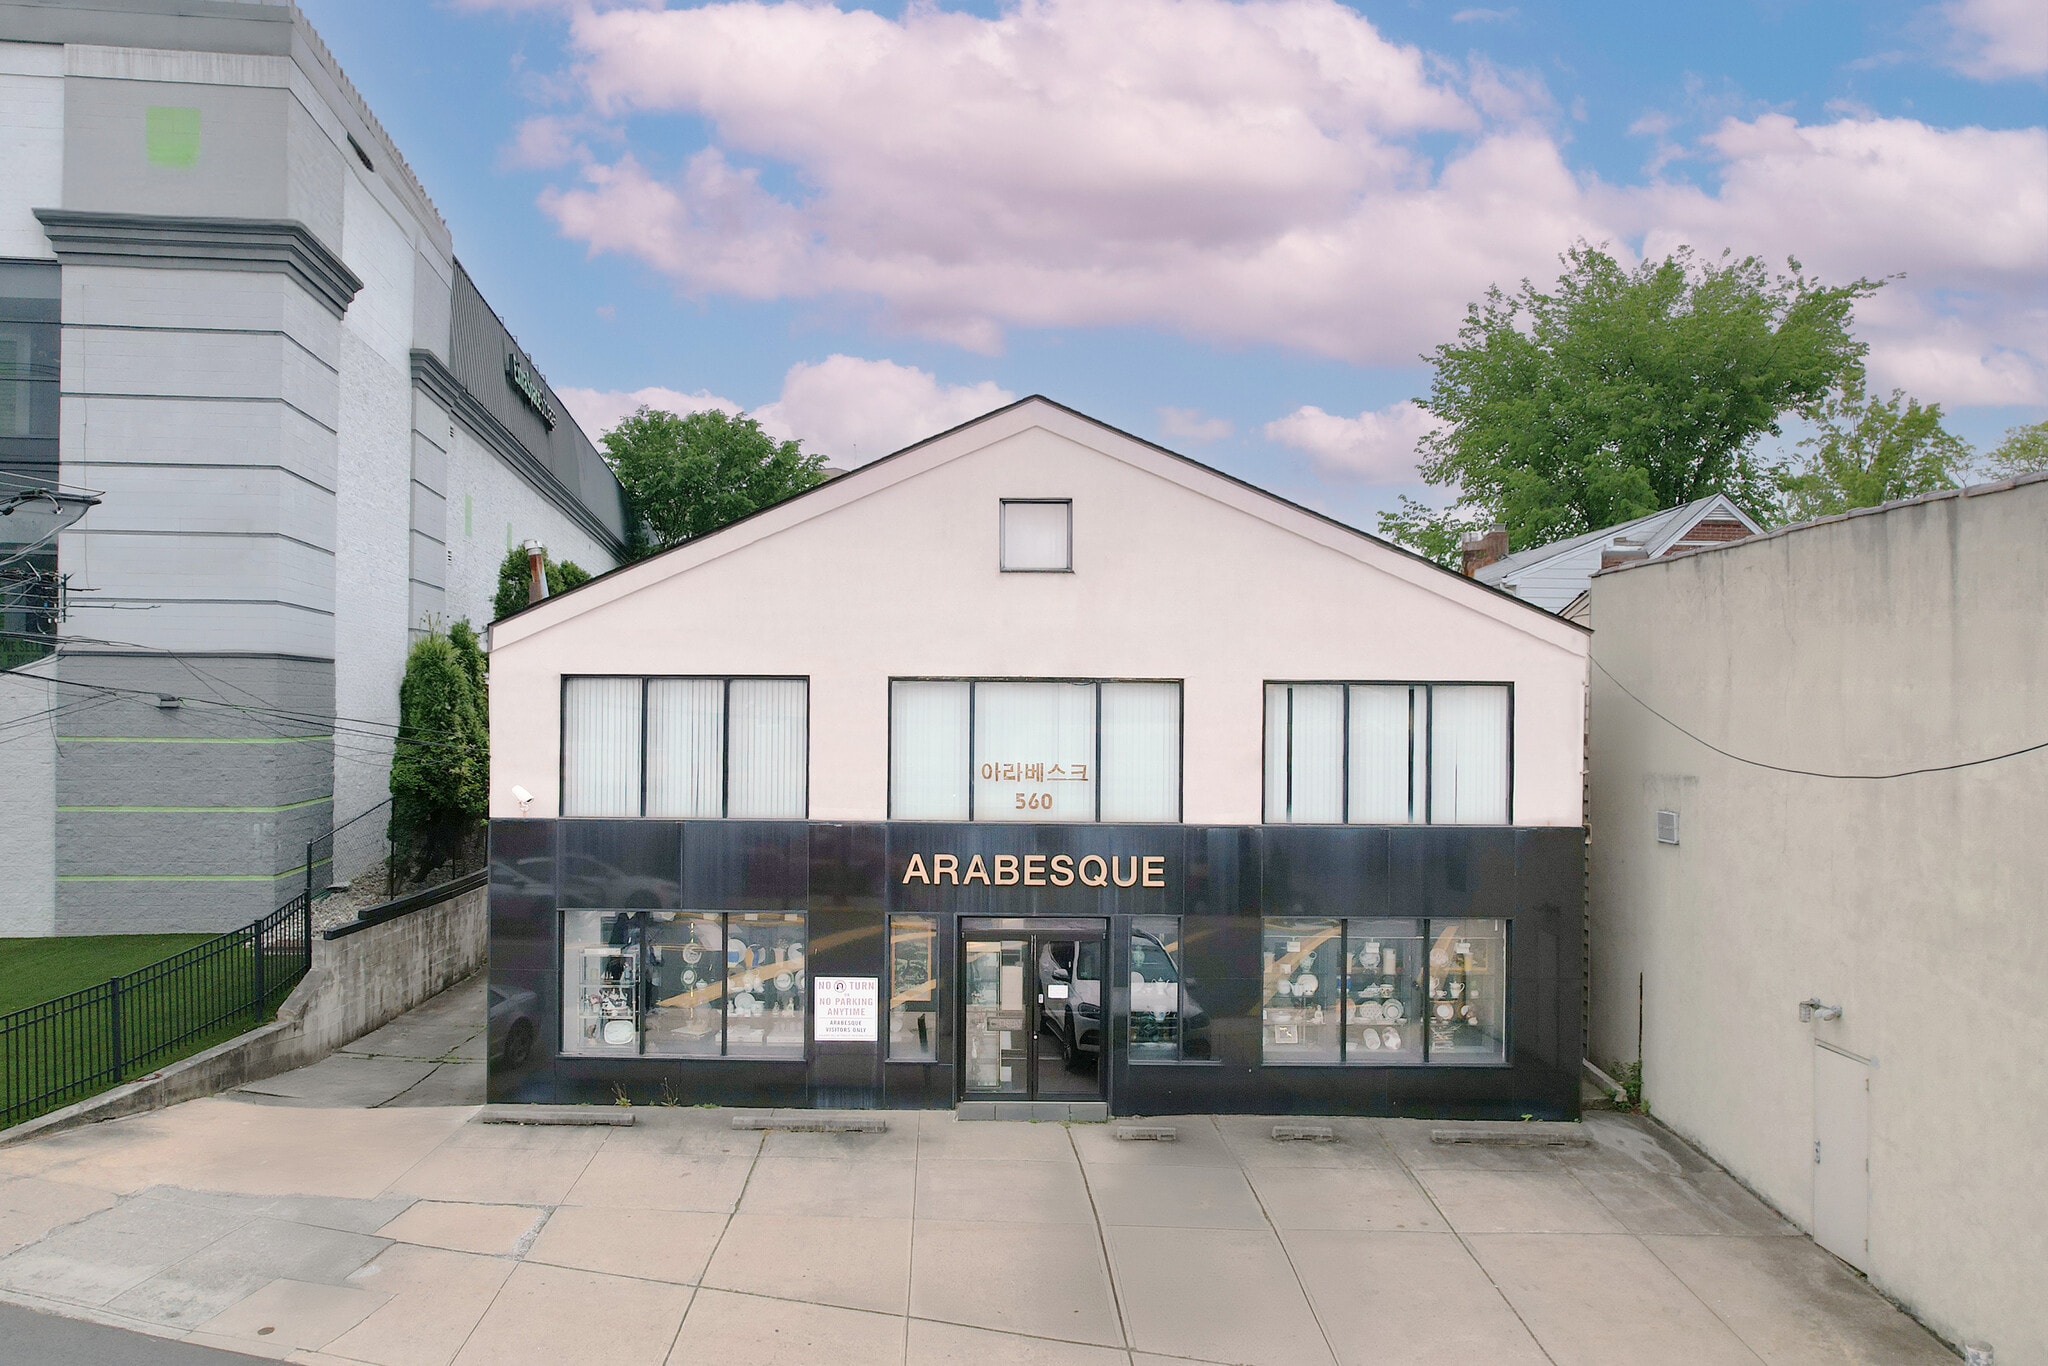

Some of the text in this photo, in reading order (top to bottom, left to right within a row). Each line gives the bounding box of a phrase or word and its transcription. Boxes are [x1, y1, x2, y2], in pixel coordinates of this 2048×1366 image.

[981, 762, 1089, 783] 아라베스크
[1015, 792, 1053, 810] 560
[902, 853, 1166, 888] ARABESQUE
[818, 981, 875, 990] NO TURN
[819, 997, 873, 1006] NO PARKING
[827, 1008, 866, 1016] ANYTIME
